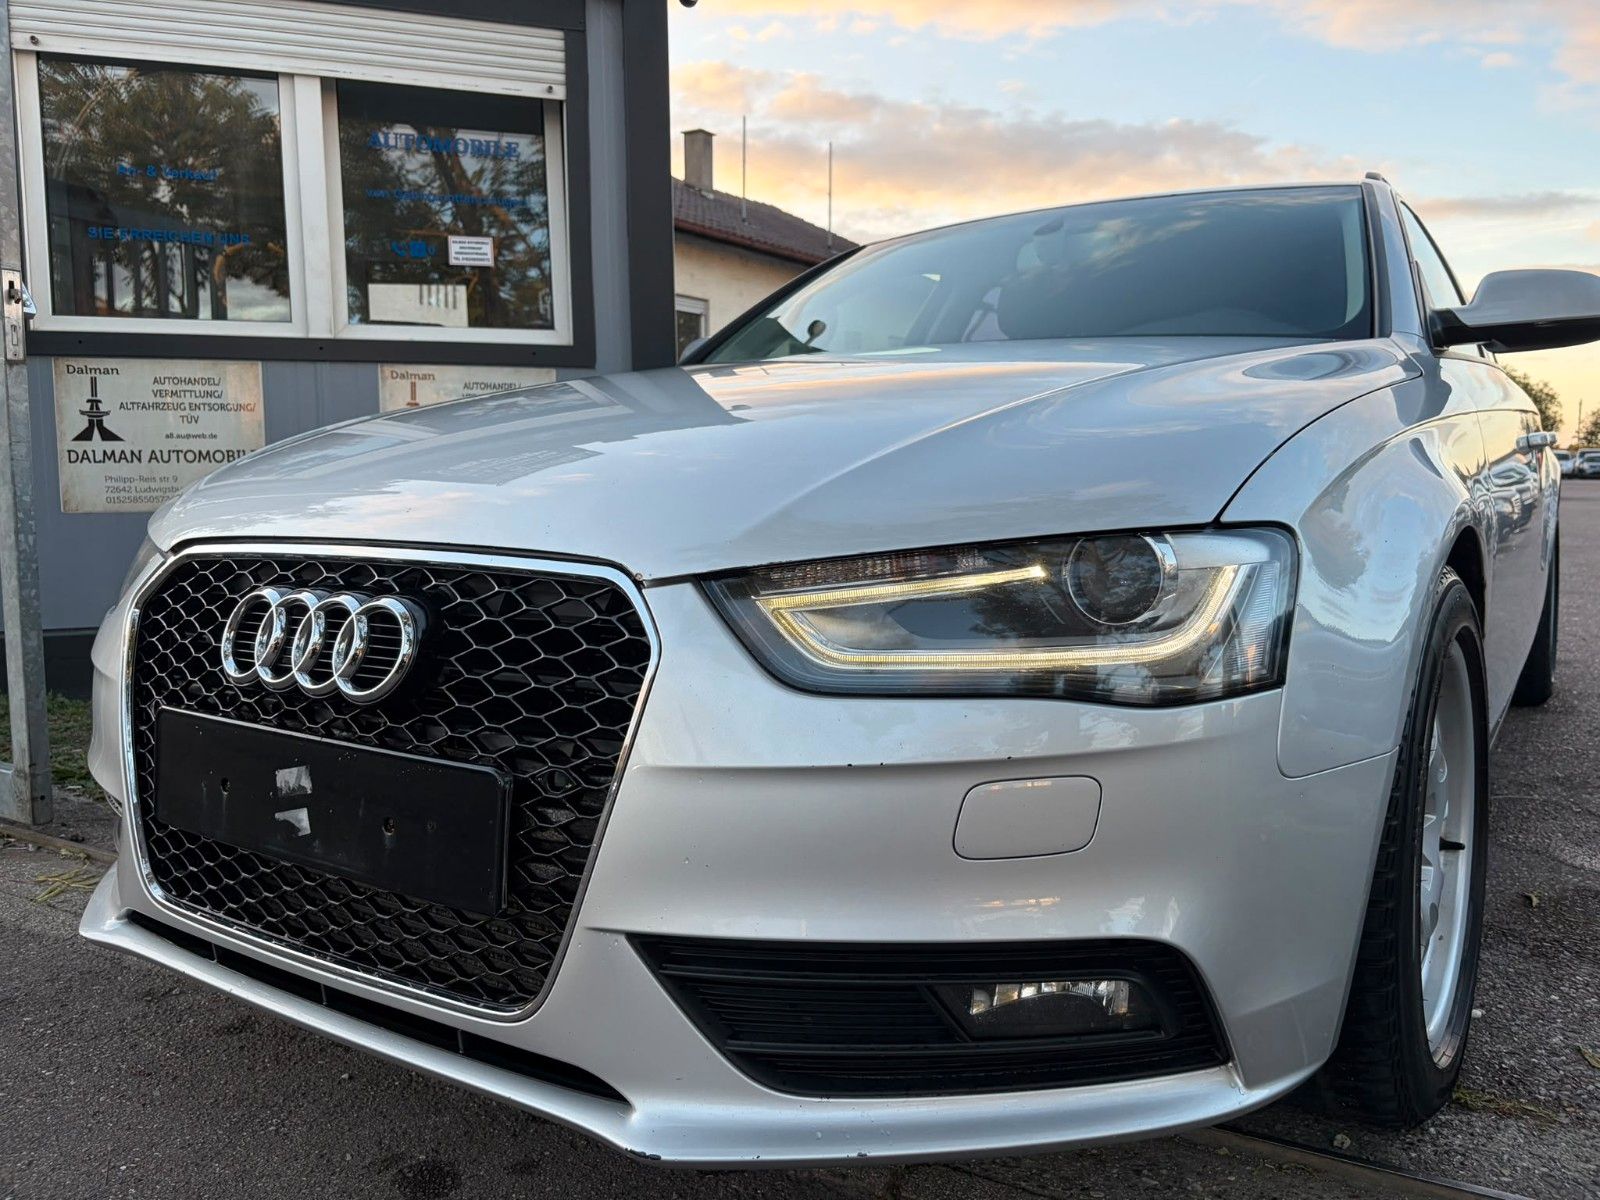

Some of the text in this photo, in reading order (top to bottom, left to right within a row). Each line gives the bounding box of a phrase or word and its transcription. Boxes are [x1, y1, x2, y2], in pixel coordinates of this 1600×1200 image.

[369, 130, 521, 160] AUTOMOBILE
[88, 226, 251, 245] SIE ERREICHEN UNS
[66, 364, 120, 376] Dalman
[390, 370, 436, 381] Dalman
[152, 376, 221, 387] AUTOHANDEL/
[152, 388, 223, 400] VERMITTLUNG/
[118, 401, 256, 413] ALTFAHRZEUG ENTSORGUNG/
[179, 413, 200, 425] TÜV
[67, 449, 142, 464] DALMAN
[104, 474, 178, 485] Philipp-Reis str 9
[105, 485, 133, 494] 72642
